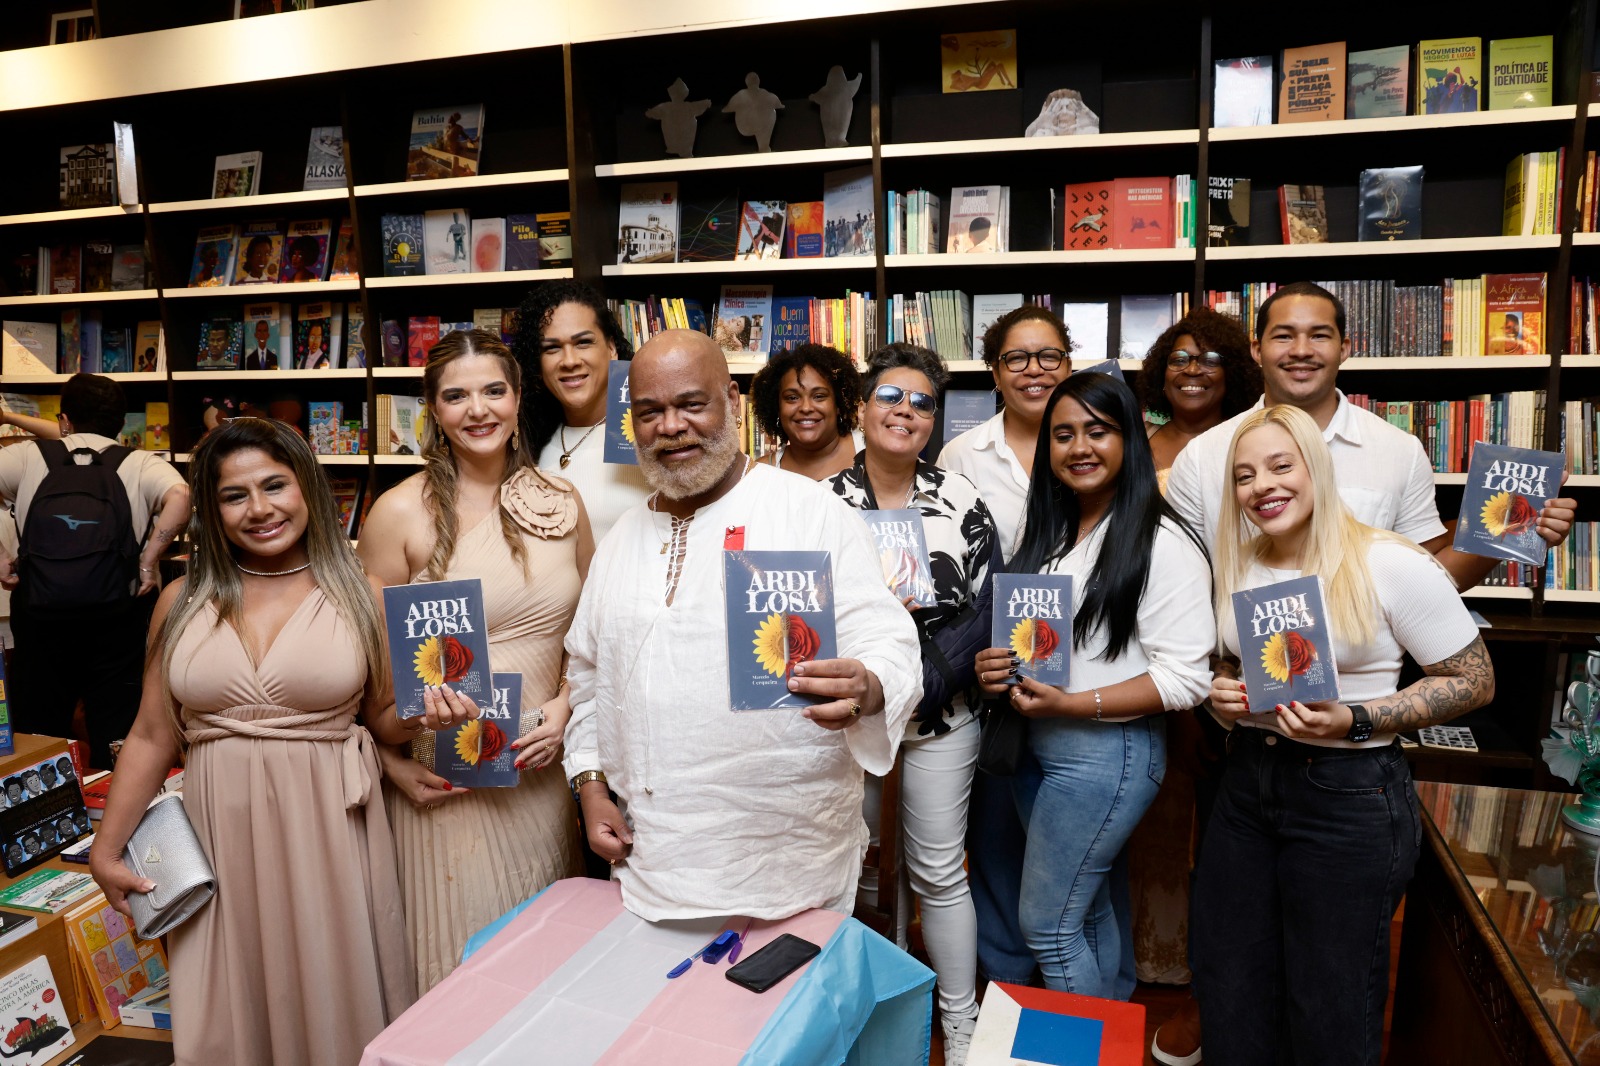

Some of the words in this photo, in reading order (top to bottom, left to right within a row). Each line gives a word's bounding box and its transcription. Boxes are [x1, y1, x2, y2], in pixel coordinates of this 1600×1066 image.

[1423, 46, 1476, 55] MOVIMENTOS
[1494, 61, 1535, 75] POLÍTICA
[1537, 62, 1548, 72] DE
[1494, 73, 1548, 86] IDENTIDADE
[417, 114, 445, 126] Bahia
[306, 164, 347, 178] ALASKA
[1208, 176, 1234, 188] CAIXA
[1208, 188, 1233, 200] PRETA
[781, 306, 804, 322] Quem
[774, 322, 792, 336] você
[772, 340, 782, 352] se
[1487, 460, 1550, 482] ARDI
[1482, 472, 1546, 498] LOSA
[870, 520, 916, 536] ARDI
[878, 534, 920, 549] OSA
[749, 570, 818, 592] ARDI
[744, 590, 823, 614] LOSA
[1009, 588, 1062, 605] ARDI
[407, 597, 470, 620] ARDI
[1006, 601, 1063, 620] LOSA
[1253, 593, 1310, 621] ARDI
[404, 616, 474, 638] LOSA
[1250, 610, 1315, 638] LOSA
[0, 990, 18, 1005] INCO
[18, 978, 40, 993] BALAS
[23, 980, 50, 999] AMÉRICA
